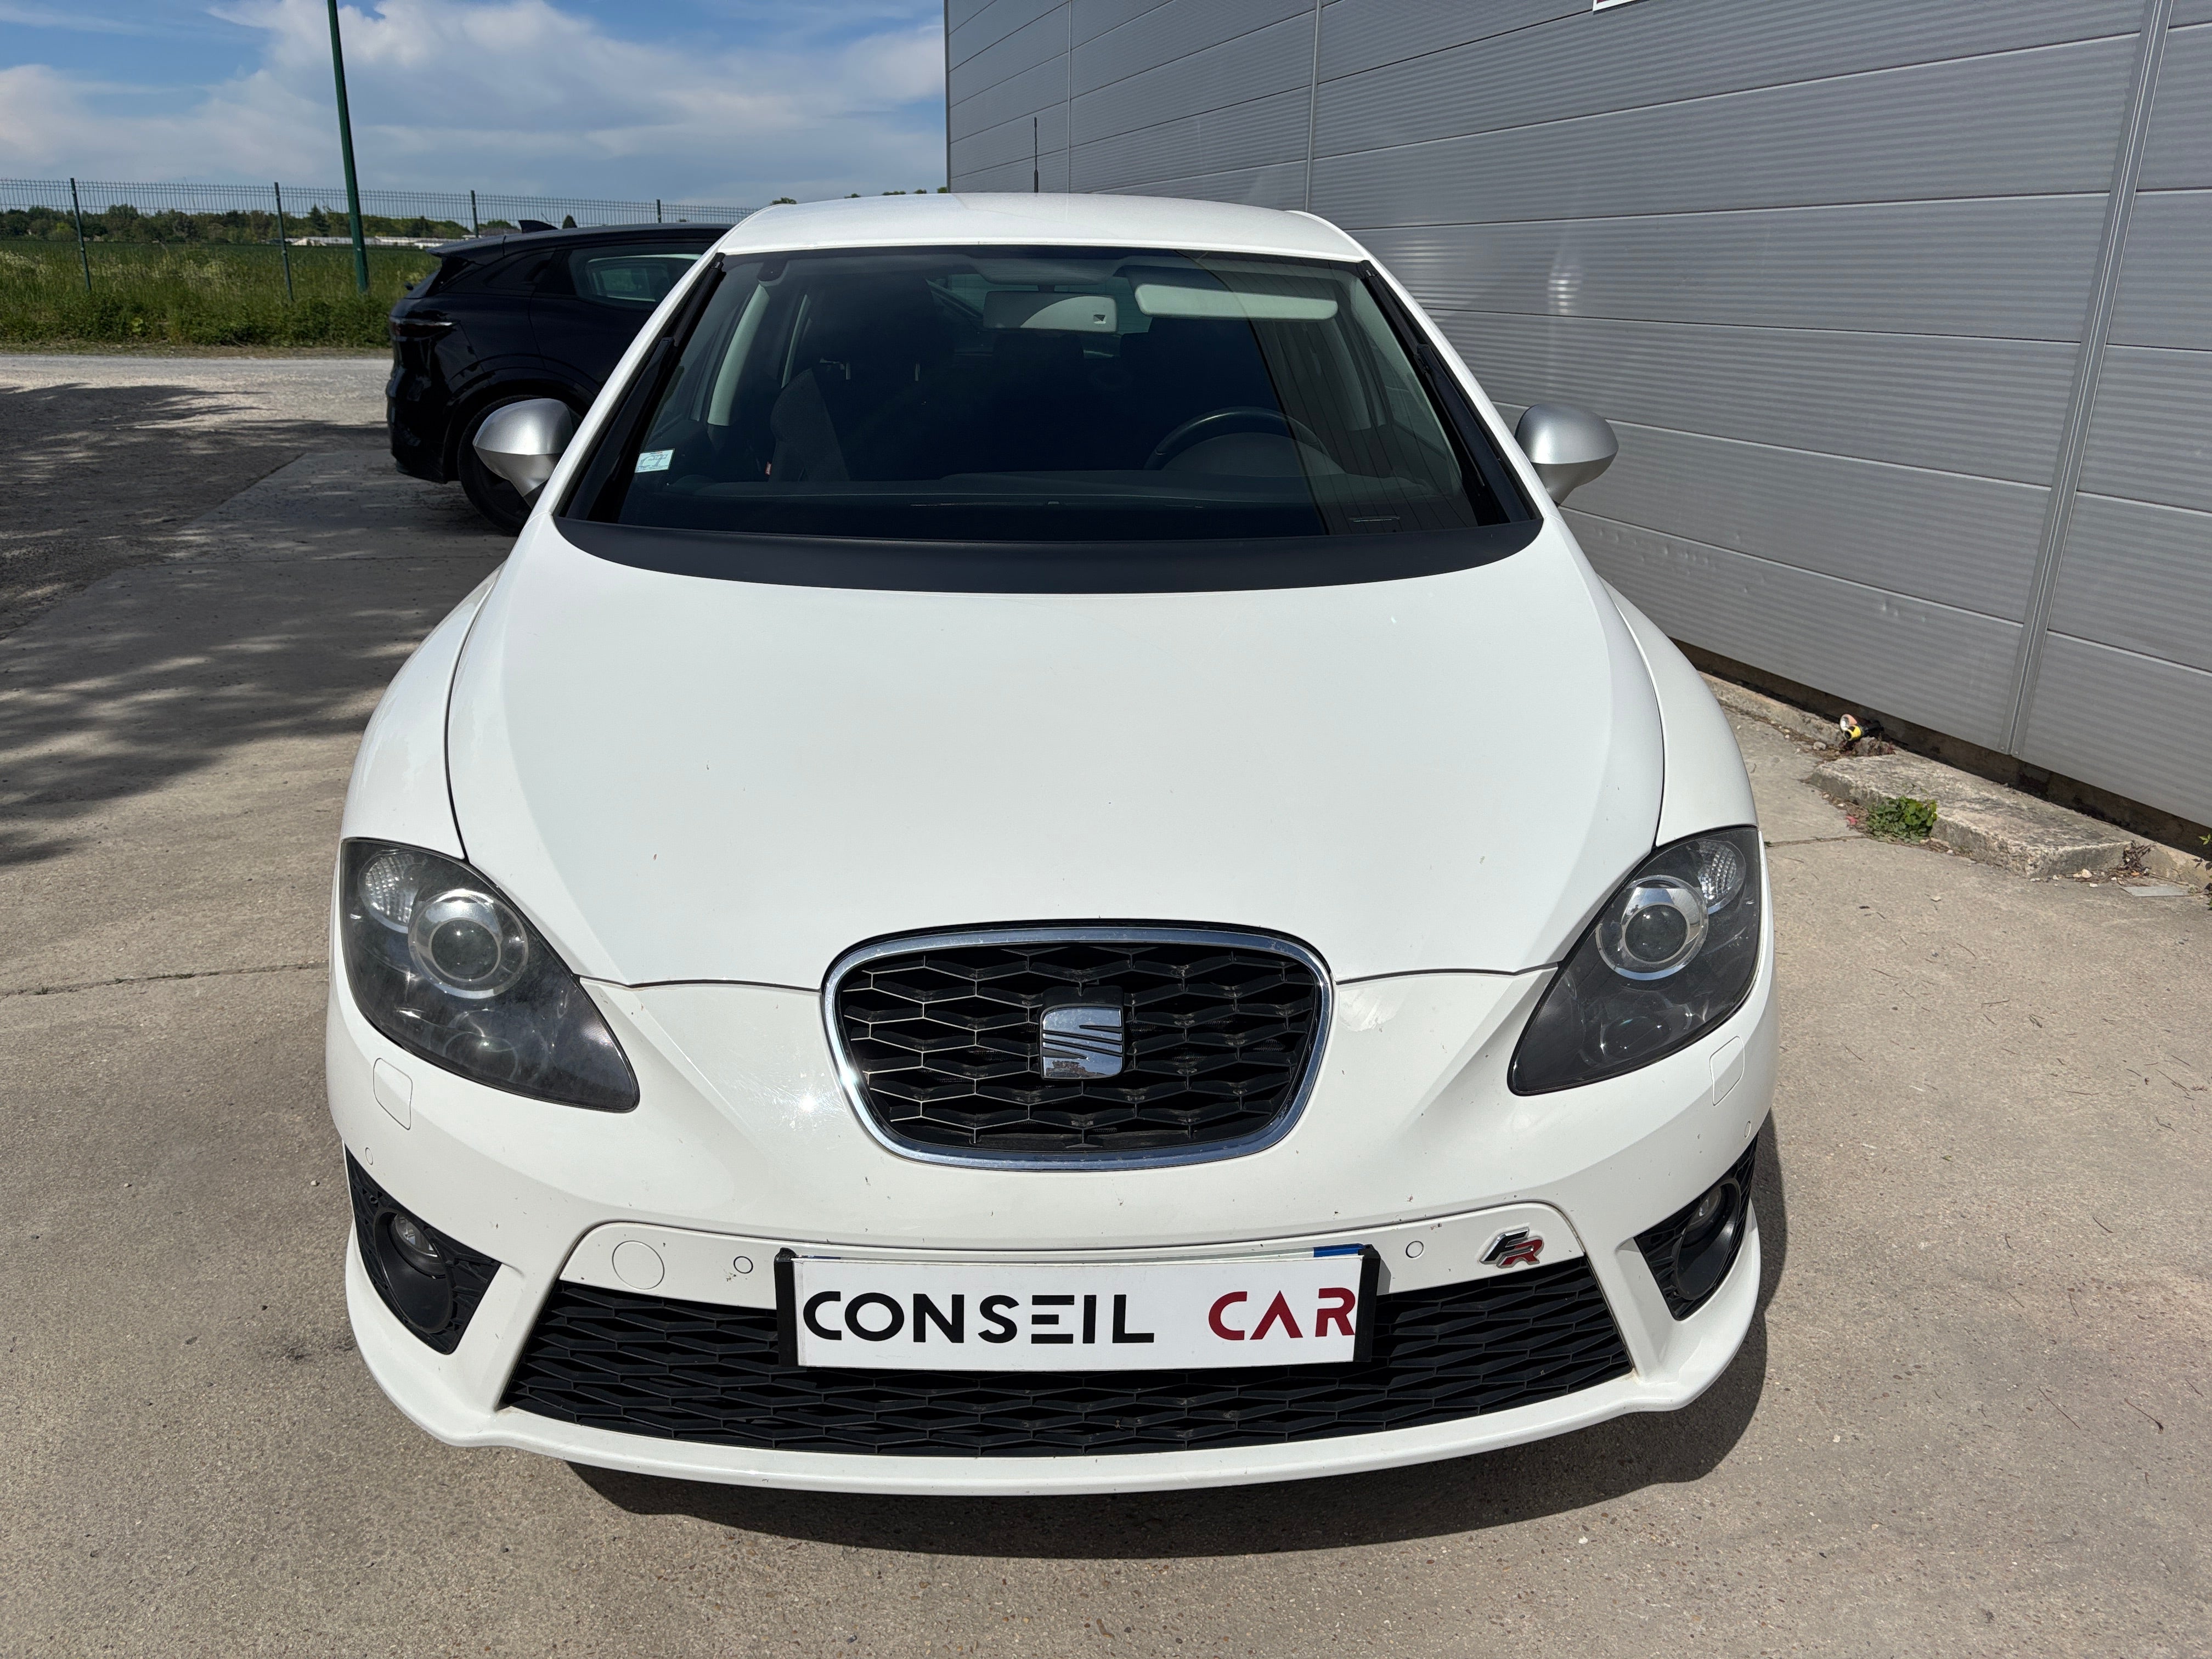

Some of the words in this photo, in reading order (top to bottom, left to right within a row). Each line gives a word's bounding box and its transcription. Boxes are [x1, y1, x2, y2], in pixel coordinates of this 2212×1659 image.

[1479, 1227, 1544, 1268] FR
[803, 1290, 1154, 1344] CONSEIL
[1208, 1287, 1356, 1340] CAR
